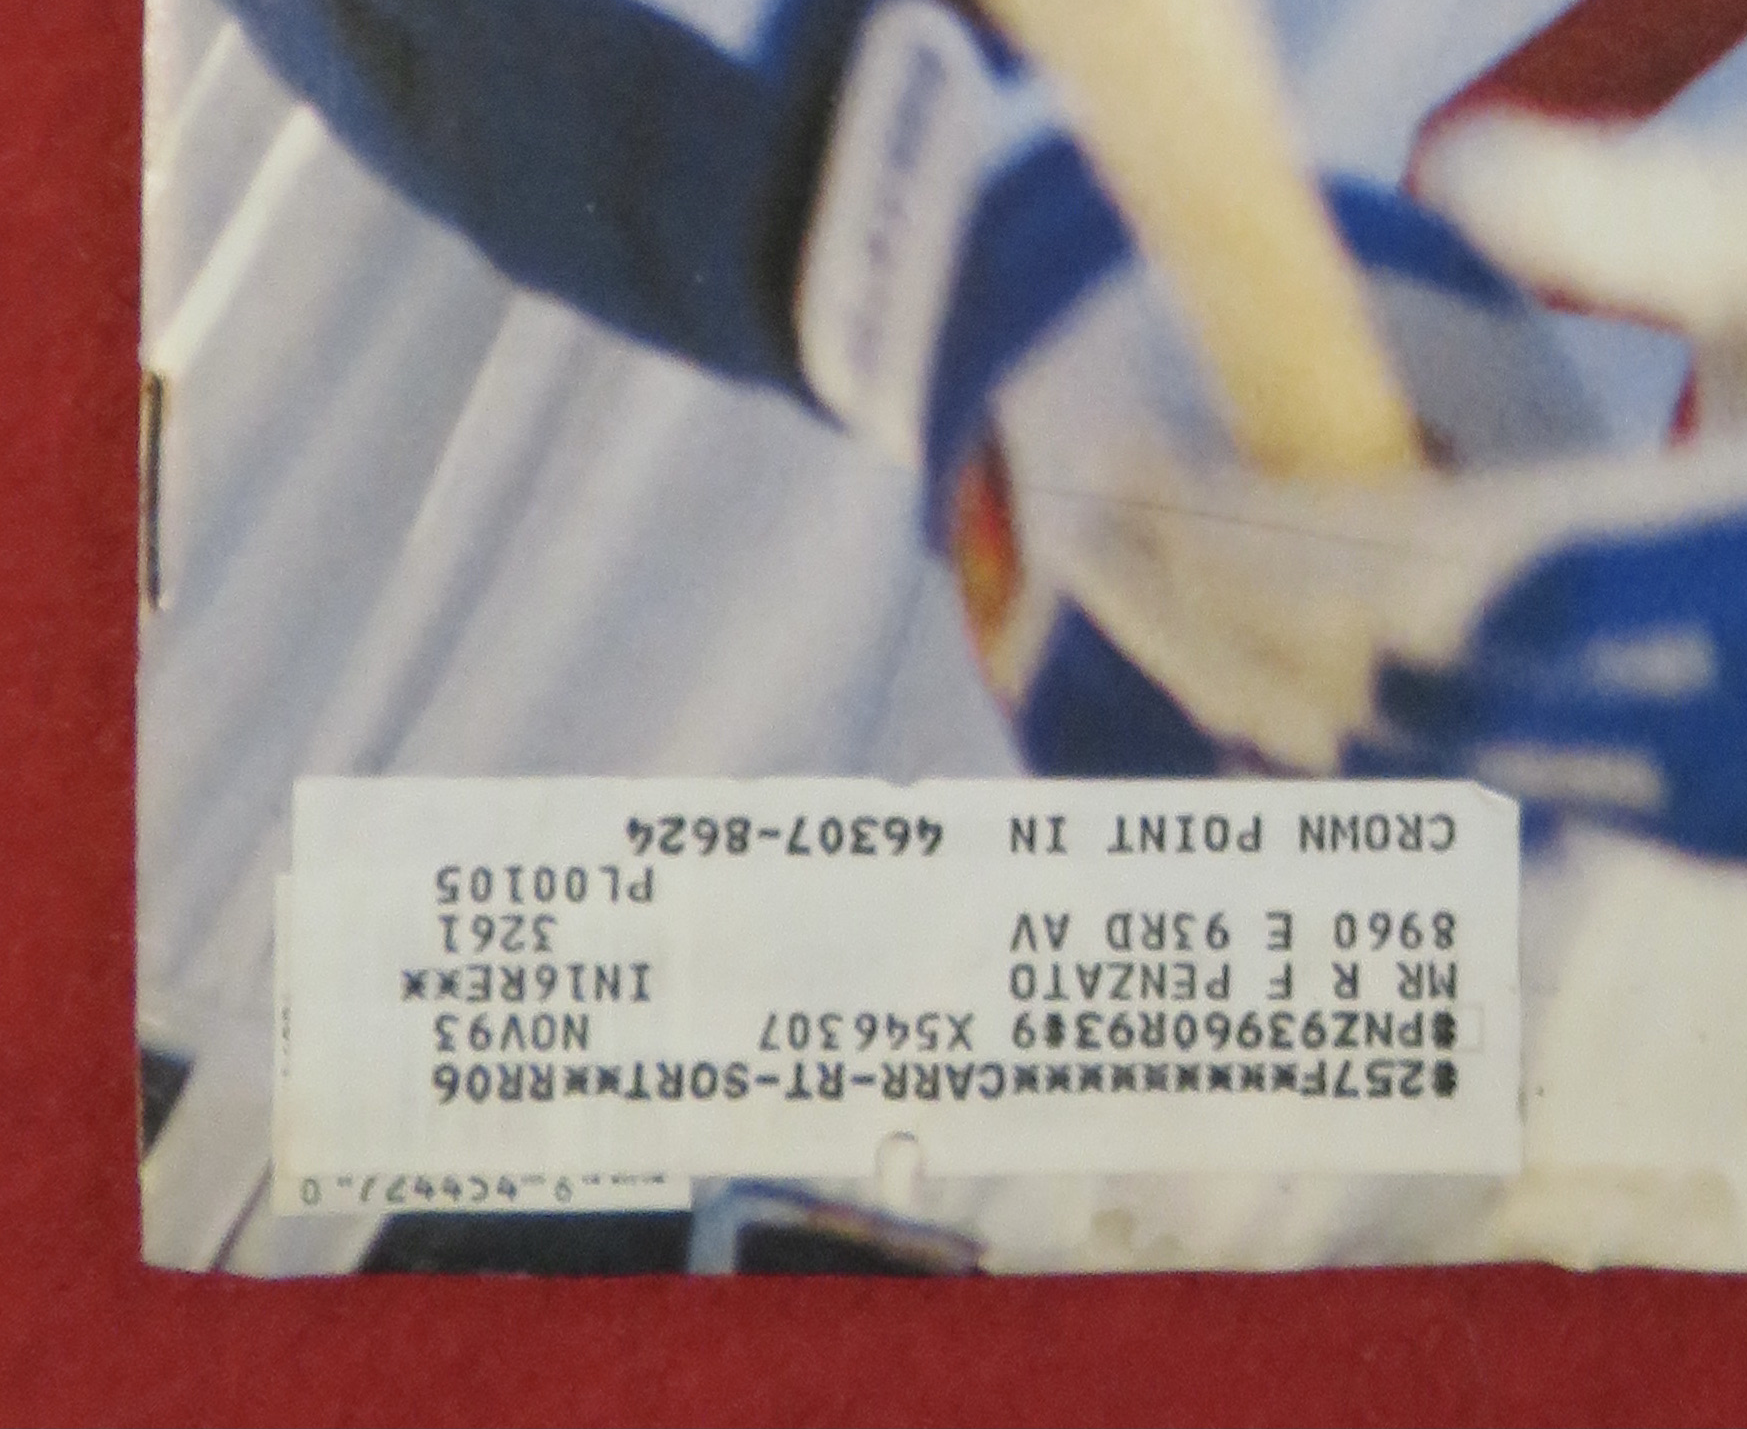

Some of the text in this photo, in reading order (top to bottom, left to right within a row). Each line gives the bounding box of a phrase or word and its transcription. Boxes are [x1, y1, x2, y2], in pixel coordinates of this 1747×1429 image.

[625, 811, 1457, 858] CROWN POINT IN 46307-8624
[435, 863, 655, 906] PL00105
[438, 912, 557, 954] 3261
[1009, 910, 1458, 953] 8960 E 93RD AV
[1008, 961, 1459, 1003] MR R F PENZATO
[433, 1012, 590, 1053] NOV93
[758, 1010, 976, 1052] X546307
